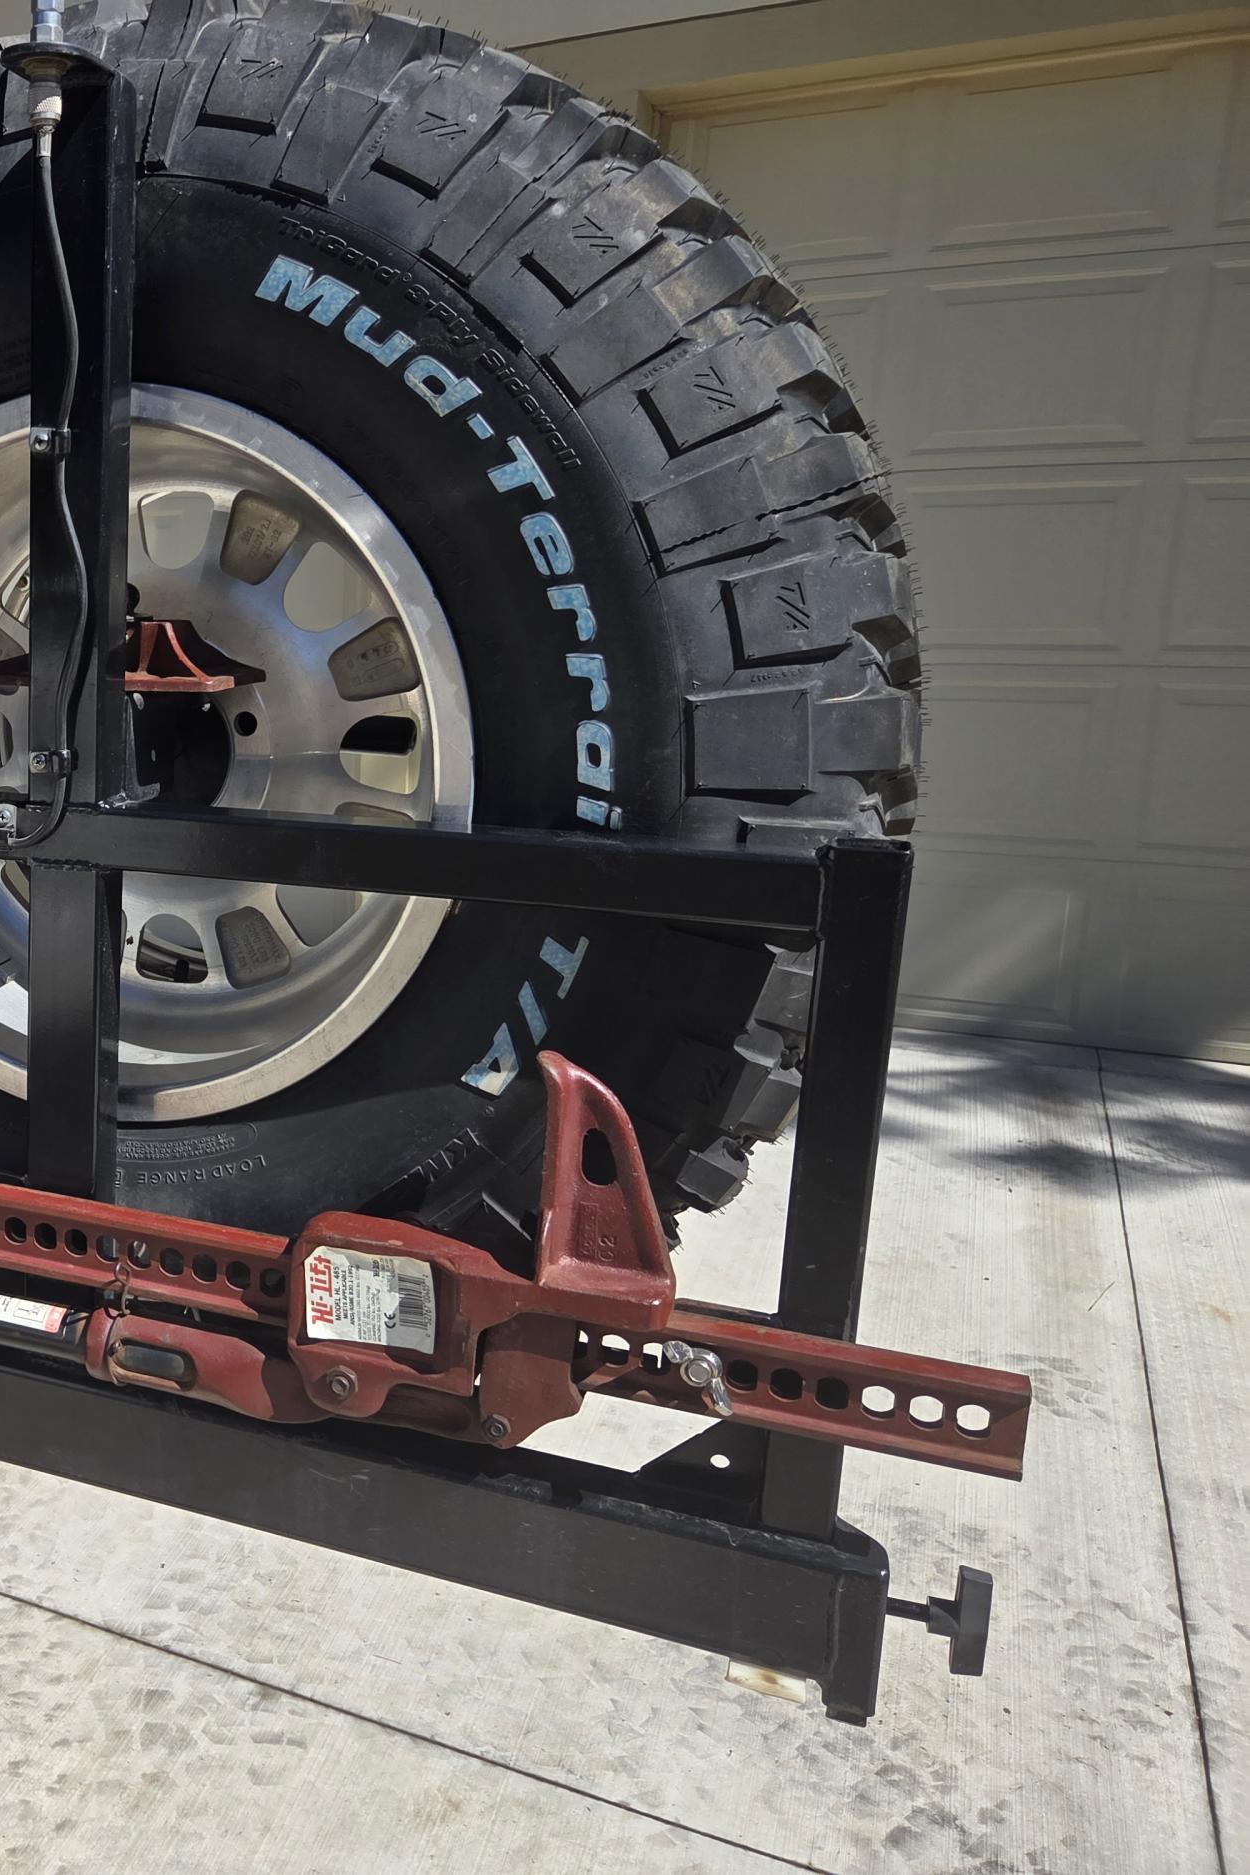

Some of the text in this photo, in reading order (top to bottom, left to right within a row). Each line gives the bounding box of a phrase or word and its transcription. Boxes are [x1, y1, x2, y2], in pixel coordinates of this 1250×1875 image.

[476, 348, 582, 471] Sidewall
[254, 254, 623, 832] Mud-Terrai
[459, 935, 590, 1097] T/A
[136, 1168, 207, 1186] RANGE
[213, 1153, 267, 1180] LOAD
[309, 1254, 334, 1325] Hi-Lift
[334, 1297, 342, 1321] MODEL
[383, 1312, 397, 1329] CE
